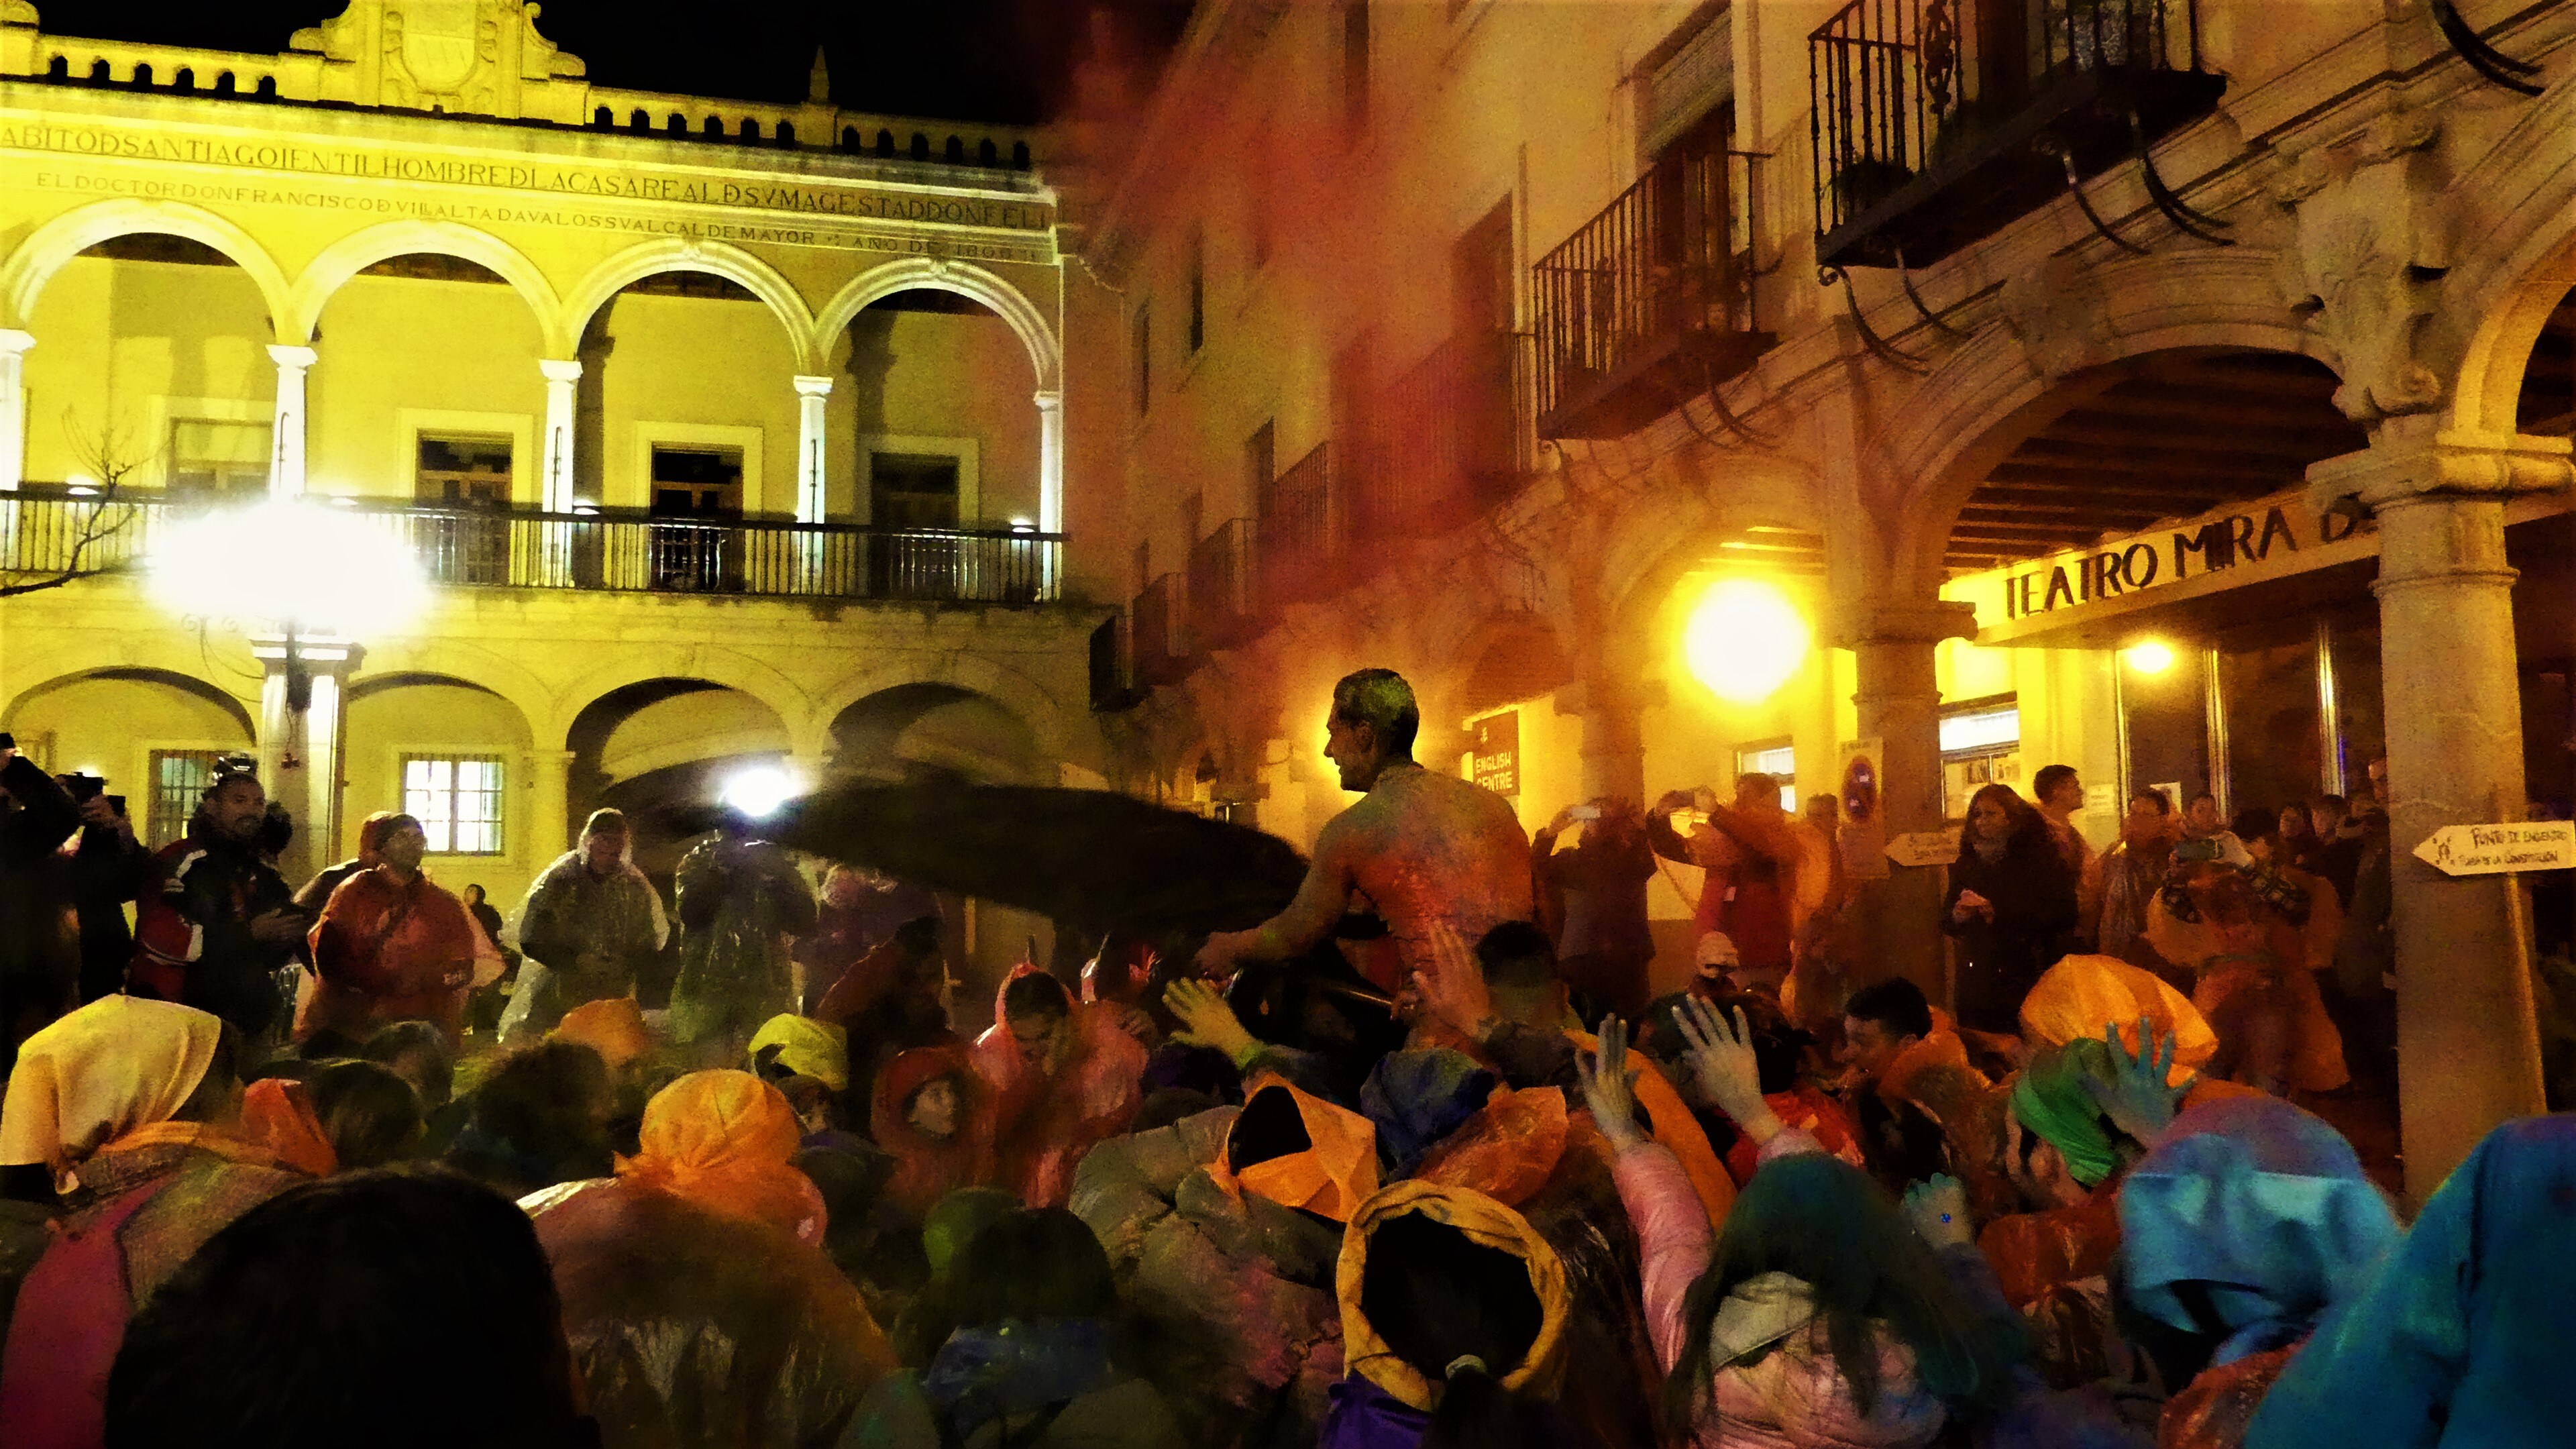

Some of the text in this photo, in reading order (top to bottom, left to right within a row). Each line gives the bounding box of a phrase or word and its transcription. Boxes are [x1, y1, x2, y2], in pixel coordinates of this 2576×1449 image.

[2005, 544, 2159, 619] TEATRO
[2174, 506, 2297, 578] MIRA
[1477, 751, 1511, 773] ENGLISH
